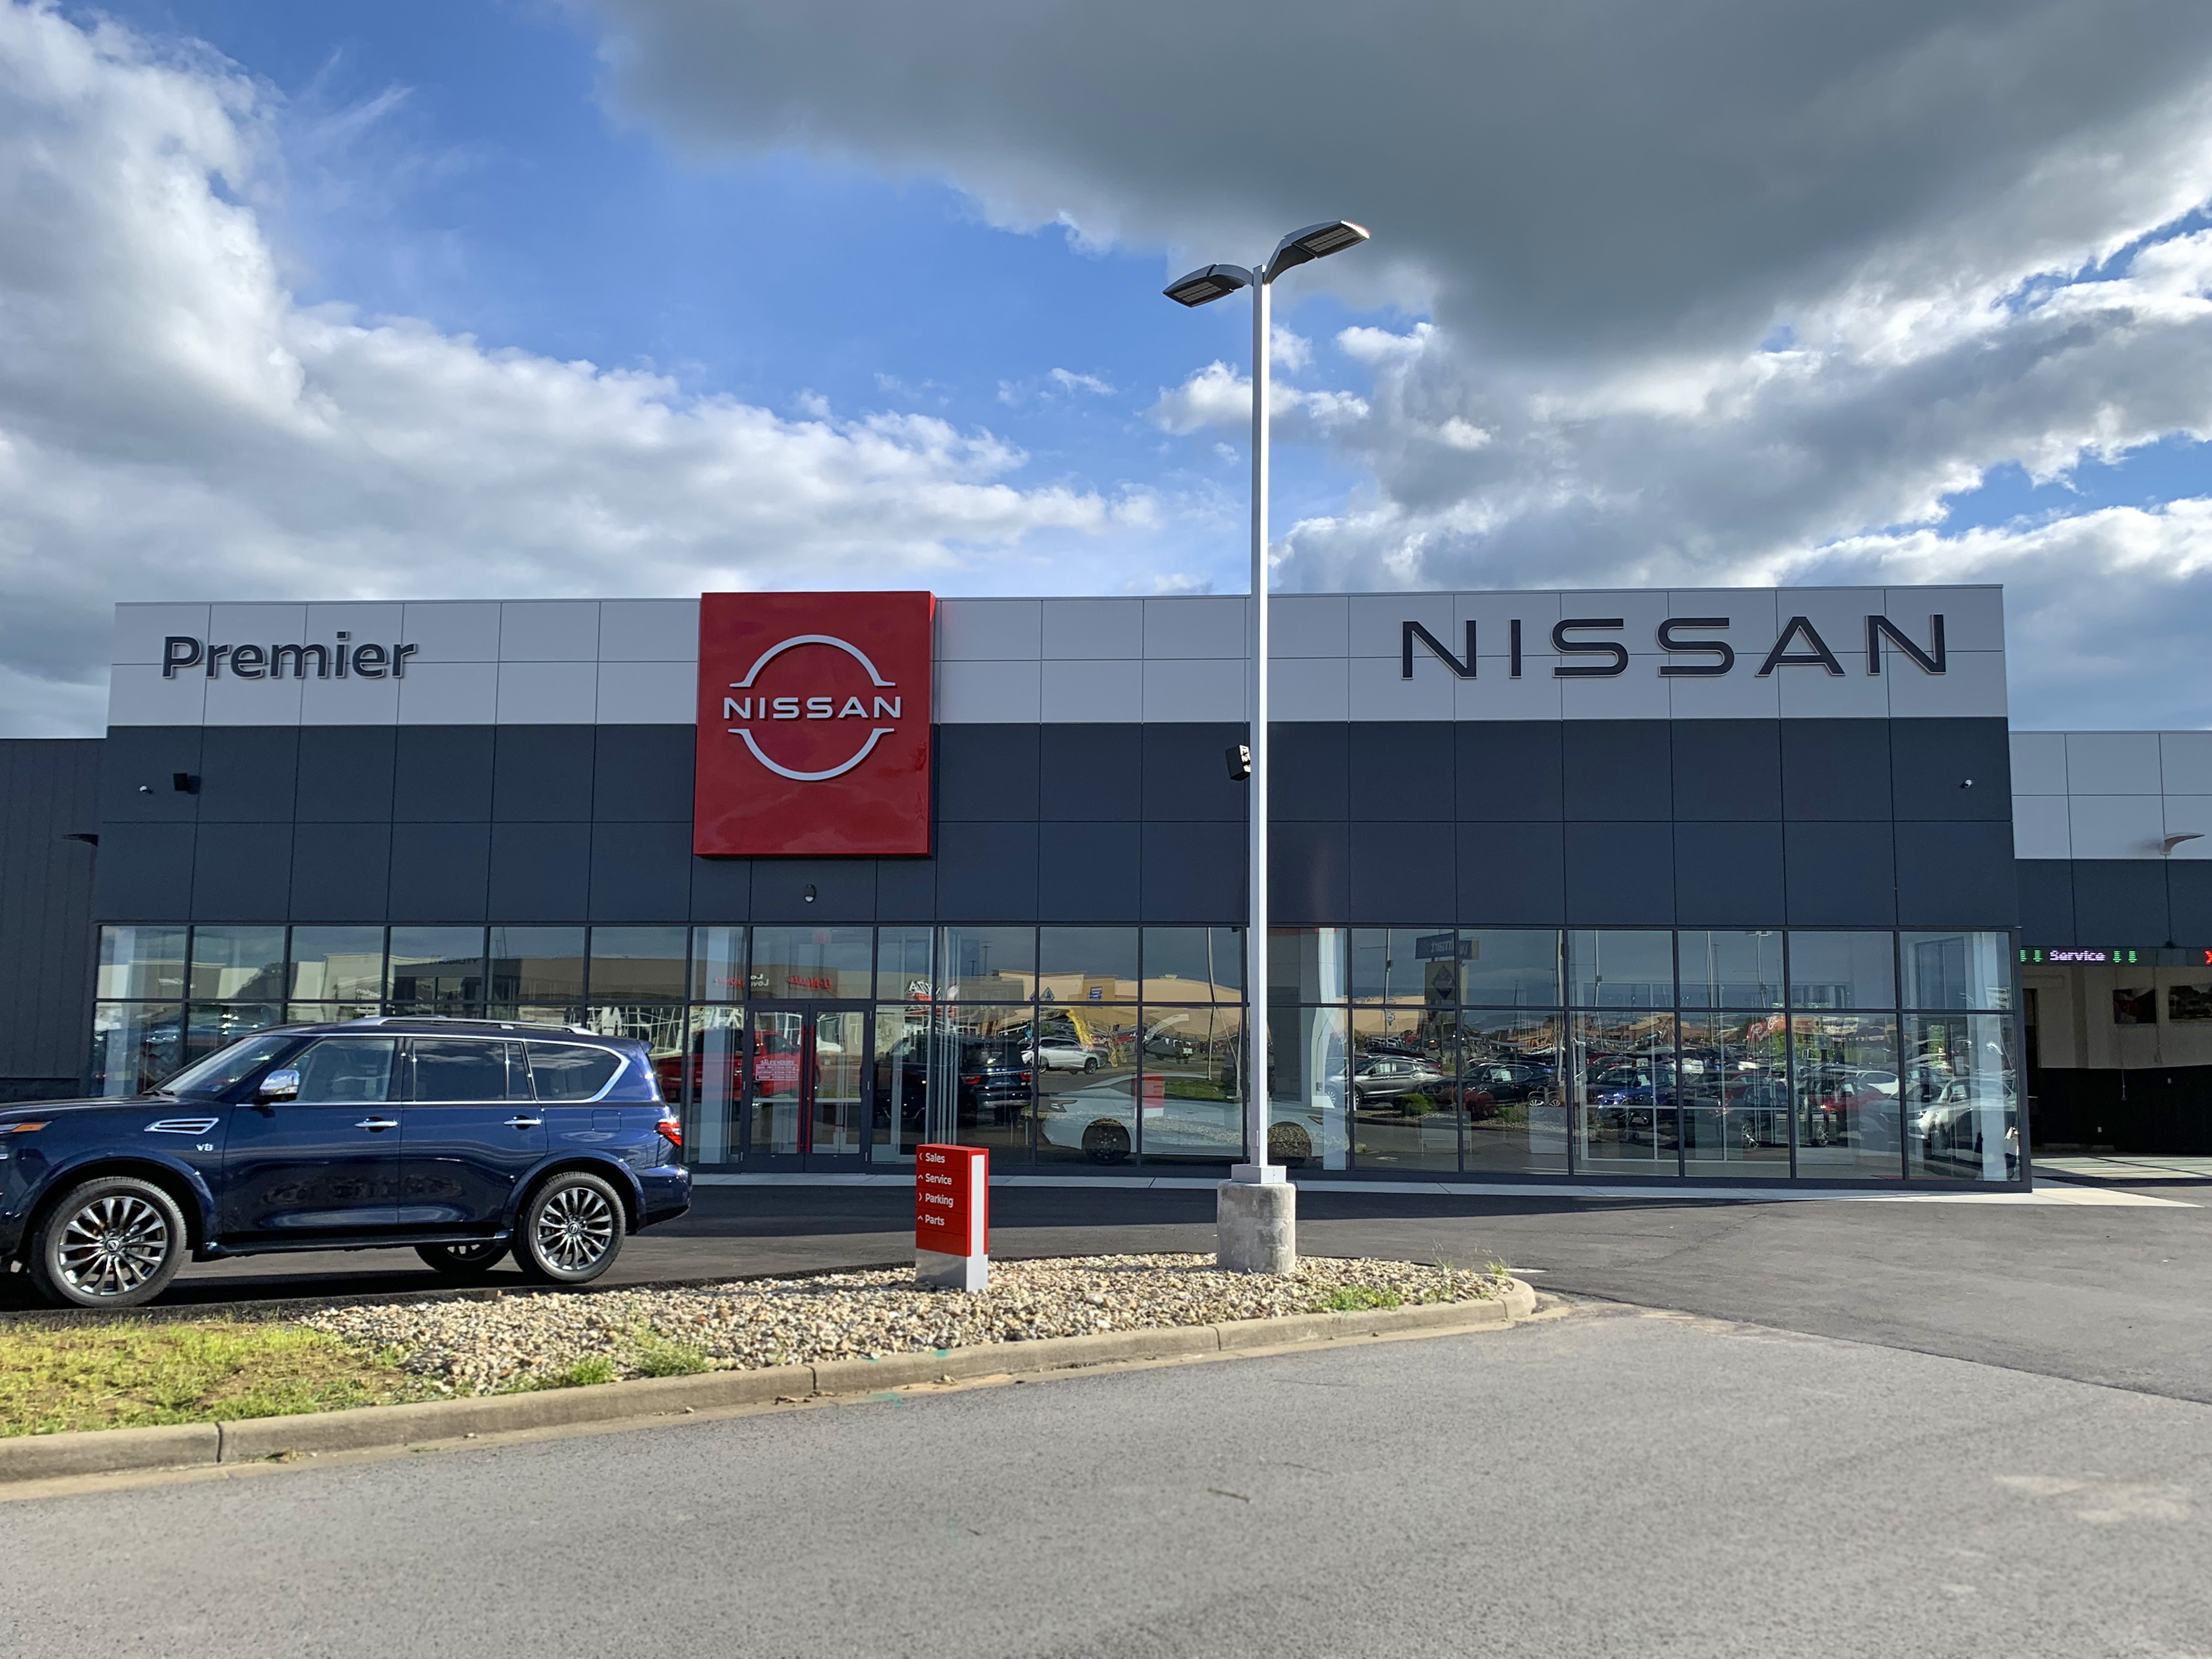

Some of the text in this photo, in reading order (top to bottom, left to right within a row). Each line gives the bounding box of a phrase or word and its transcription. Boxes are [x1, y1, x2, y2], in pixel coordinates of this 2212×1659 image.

[1401, 614, 1947, 680] NISSAN
[162, 631, 418, 679] Premier
[724, 696, 901, 719] NISSAN
[2050, 950, 2105, 960] Service
[196, 1143, 213, 1151] V8
[925, 1153, 945, 1163] Sales
[925, 1173, 952, 1185] Service
[925, 1193, 953, 1208] Parking
[925, 1214, 945, 1226] Parts
